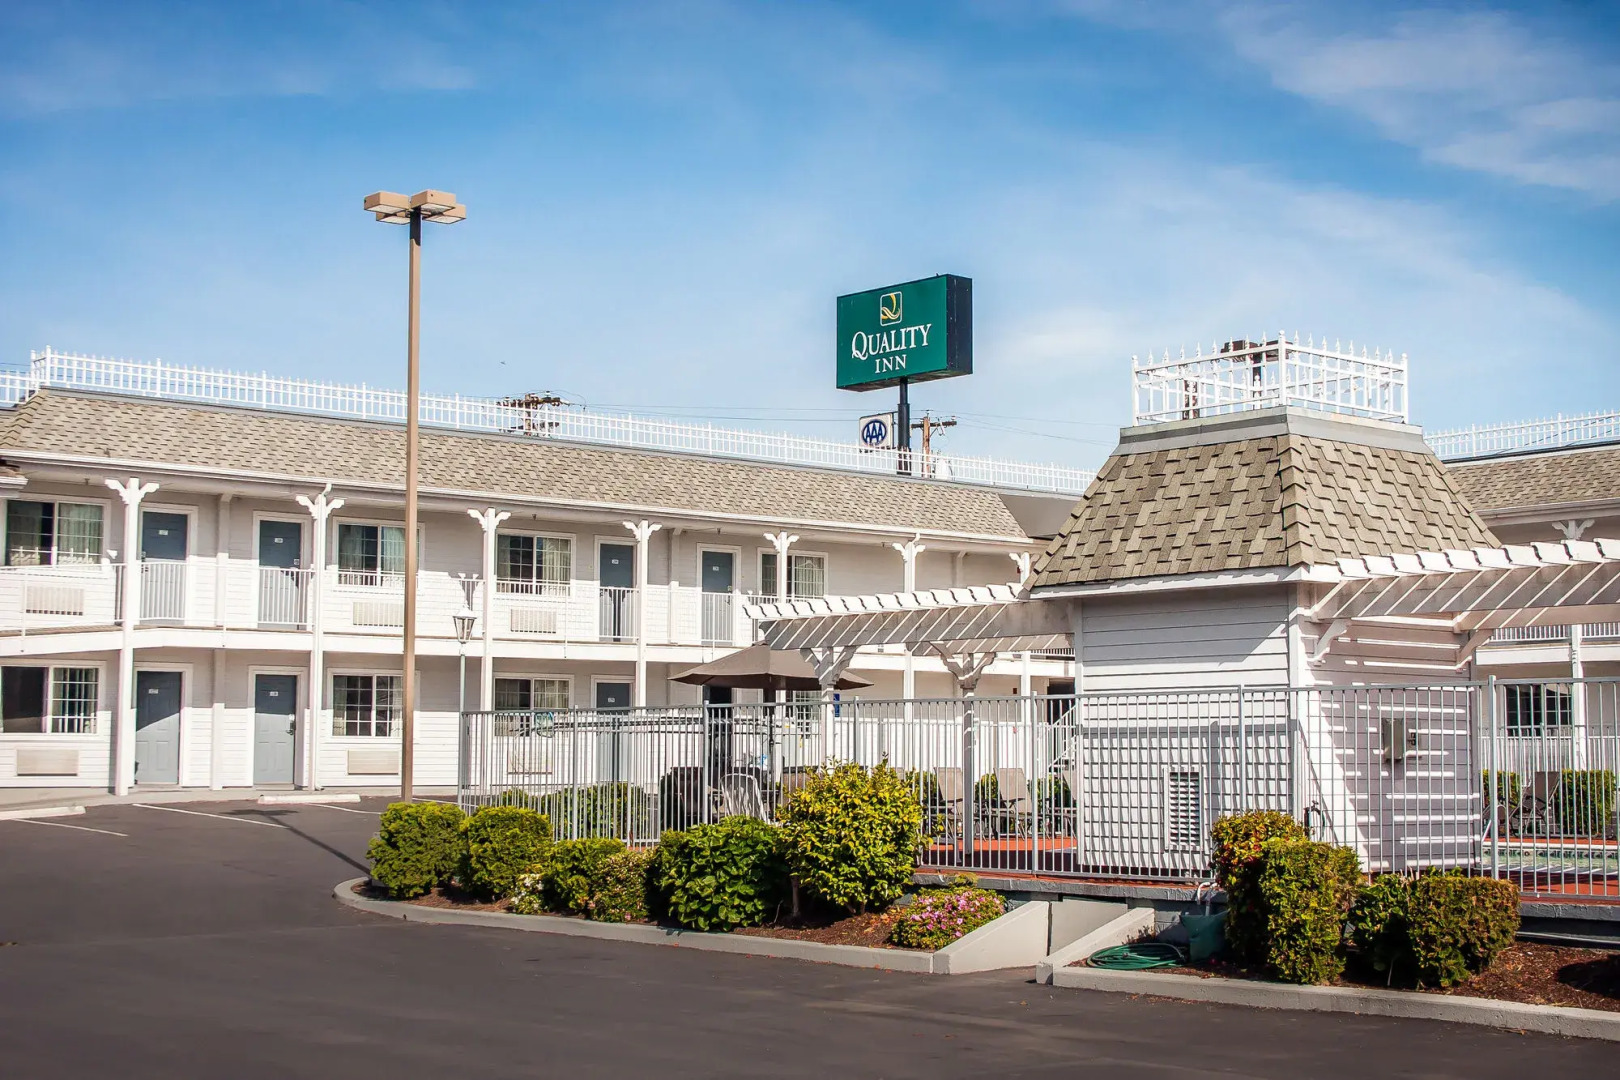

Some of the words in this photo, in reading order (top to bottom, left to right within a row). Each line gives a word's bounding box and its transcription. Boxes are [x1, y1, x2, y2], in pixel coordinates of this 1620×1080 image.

[851, 323, 932, 361] QUALITY
[874, 354, 907, 374] INN
[864, 421, 884, 444] AAA
